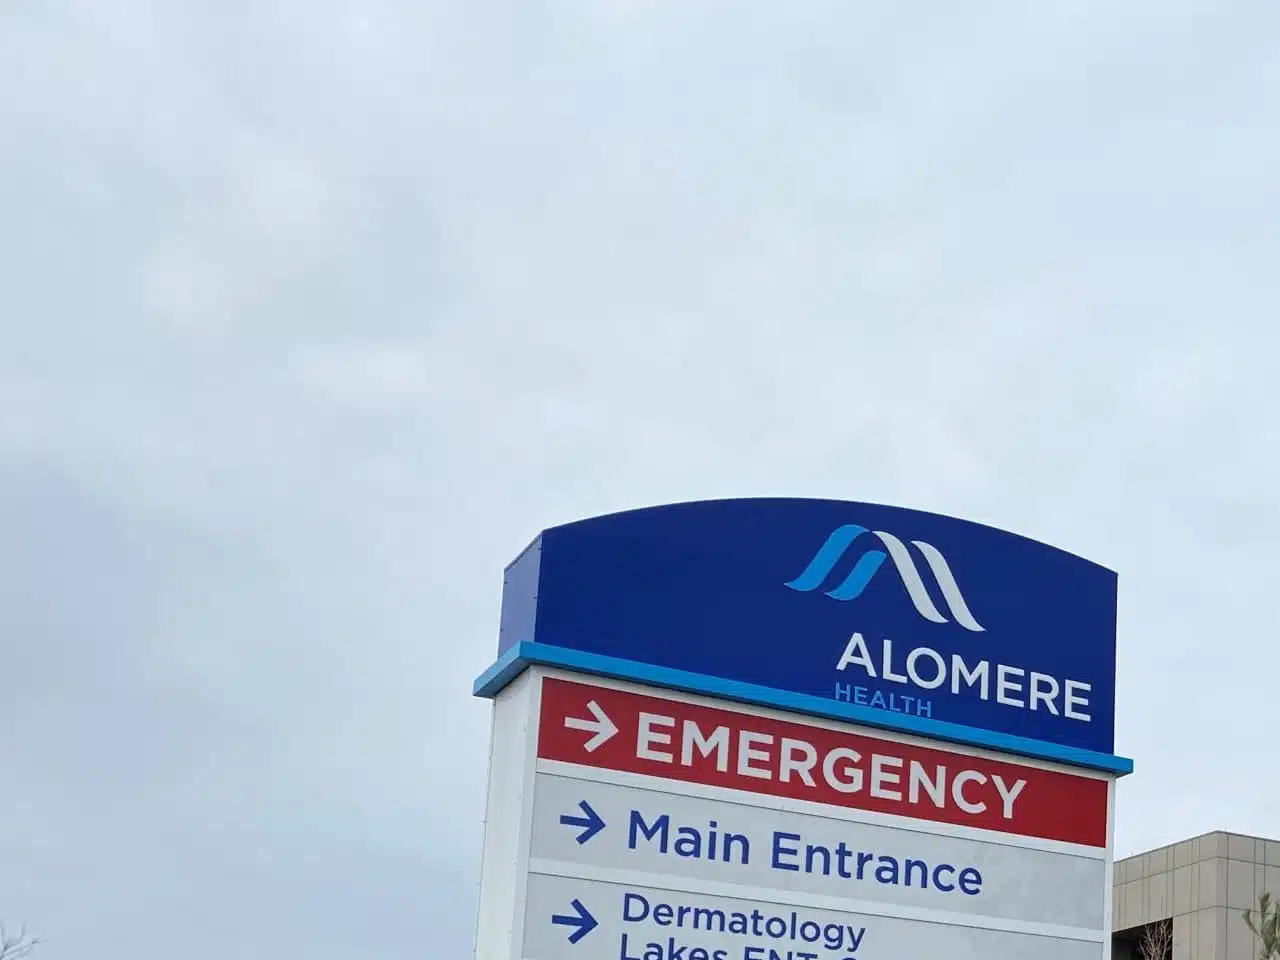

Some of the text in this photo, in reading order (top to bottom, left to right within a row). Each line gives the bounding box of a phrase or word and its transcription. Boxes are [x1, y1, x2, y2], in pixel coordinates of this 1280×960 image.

[835, 682, 932, 718] HEALTH
[836, 632, 1092, 722] ALOMERE
[636, 712, 1027, 819] EMERGENCY
[628, 810, 983, 896] Main Entrance
[622, 893, 866, 952] Dermatology
